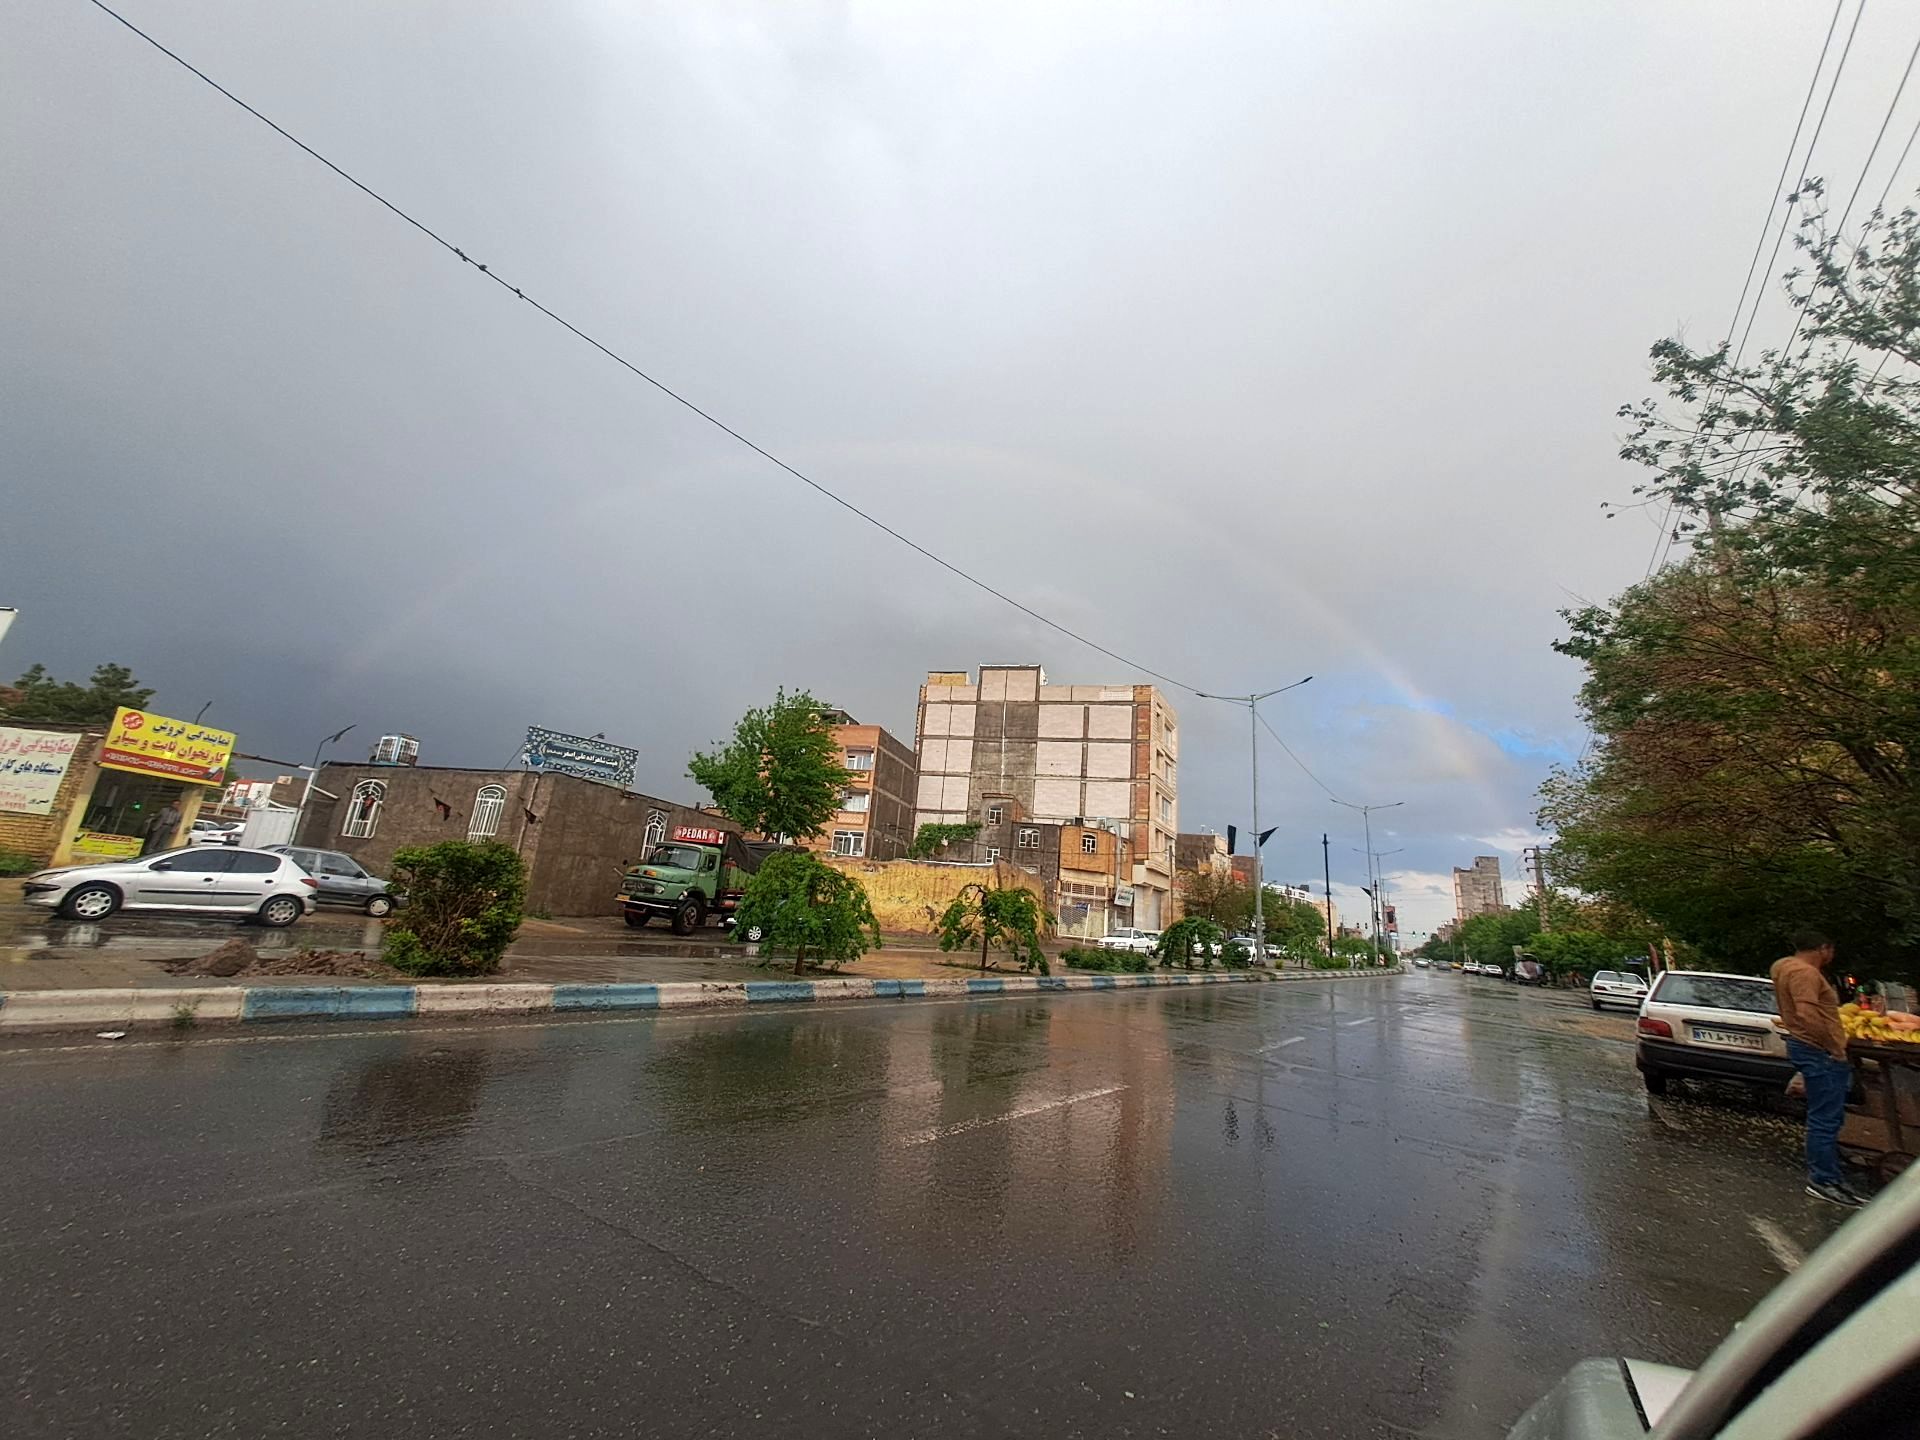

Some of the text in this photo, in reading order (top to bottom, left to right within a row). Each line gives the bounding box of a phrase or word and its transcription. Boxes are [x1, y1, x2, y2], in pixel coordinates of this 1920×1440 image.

[153, 721, 186, 737] فروش
[111, 731, 139, 746] سیار
[142, 739, 149, 750] و
[187, 730, 231, 746] نمایندگی
[152, 740, 177, 753] ثابت
[177, 746, 226, 764] کارتخوان
[14, 760, 33, 774] های
[34, 761, 63, 774] دستگاه
[681, 827, 708, 840] PEDAR
